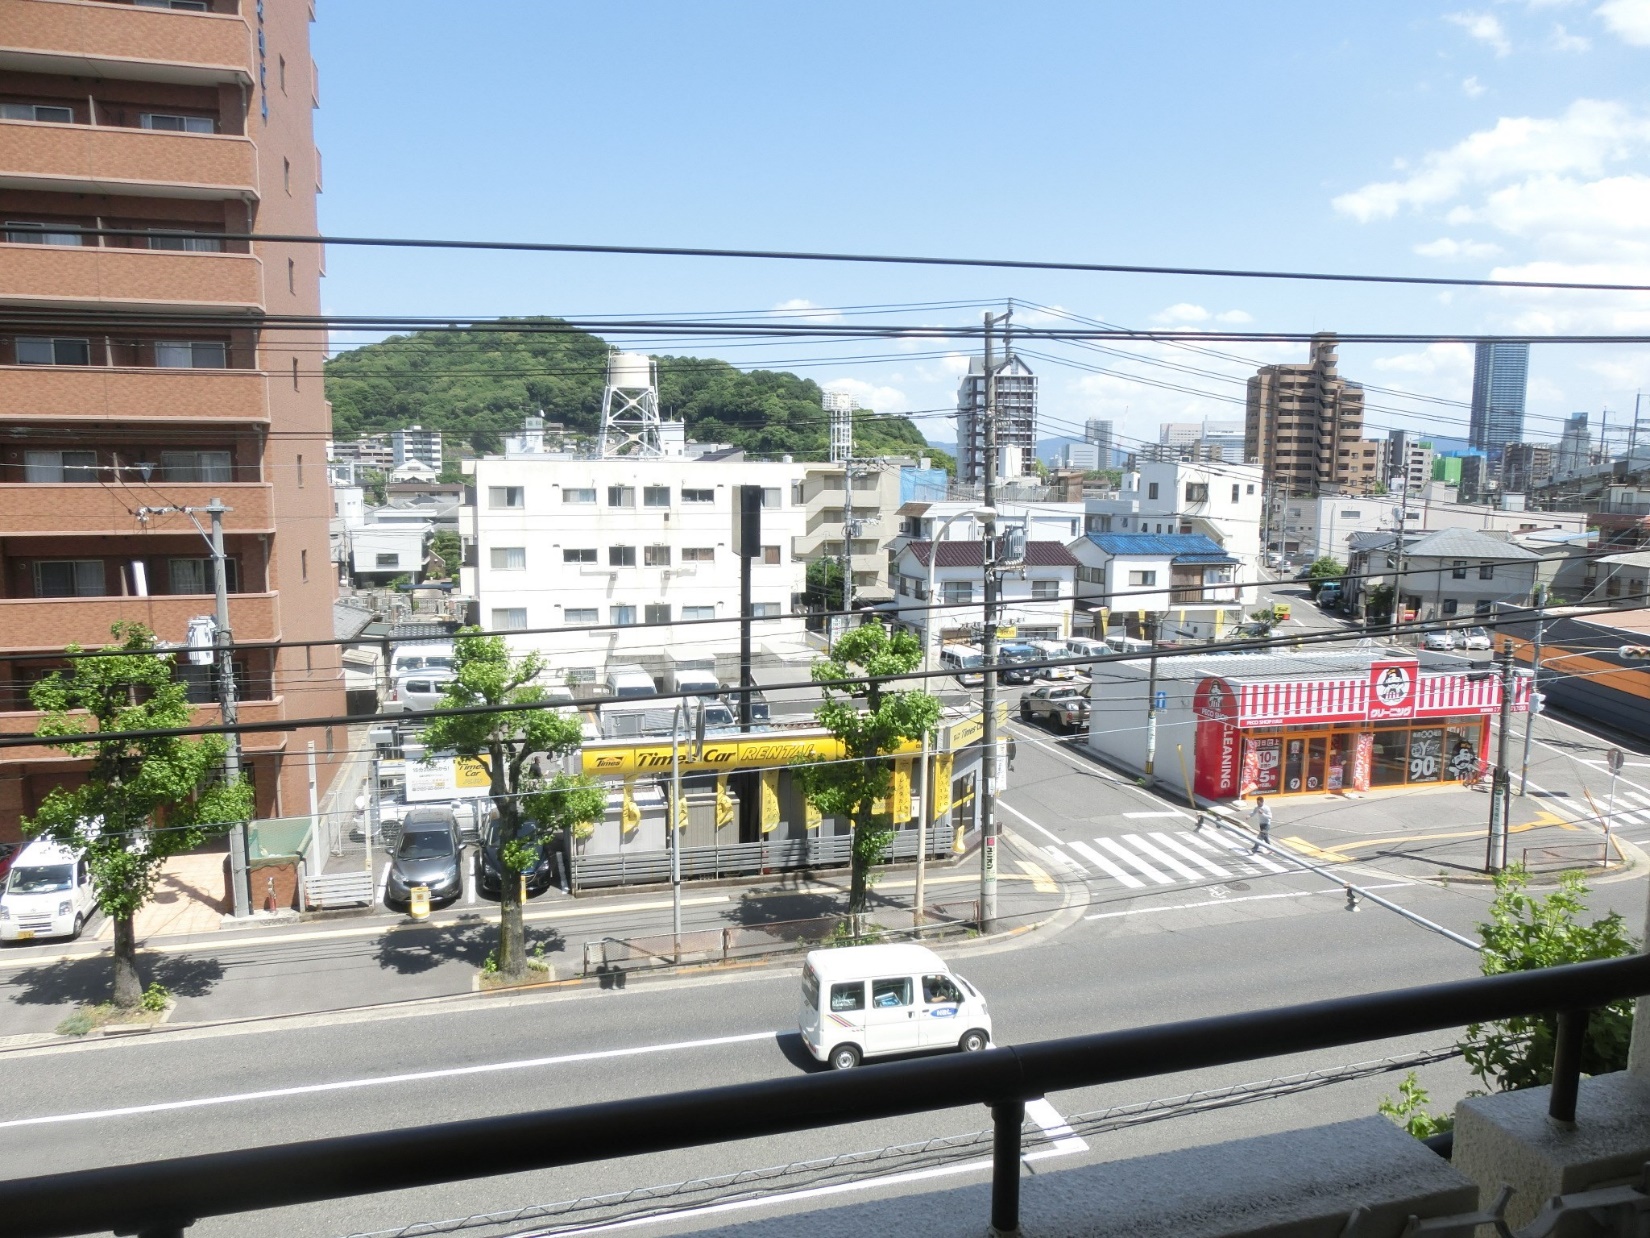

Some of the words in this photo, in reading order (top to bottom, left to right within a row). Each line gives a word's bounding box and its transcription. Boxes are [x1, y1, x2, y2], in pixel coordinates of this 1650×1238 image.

[1371, 706, 1412, 718] クリーニング
[703, 749, 736, 762] Car
[1220, 724, 1234, 789] CLEANING
[597, 757, 624, 768] Times
